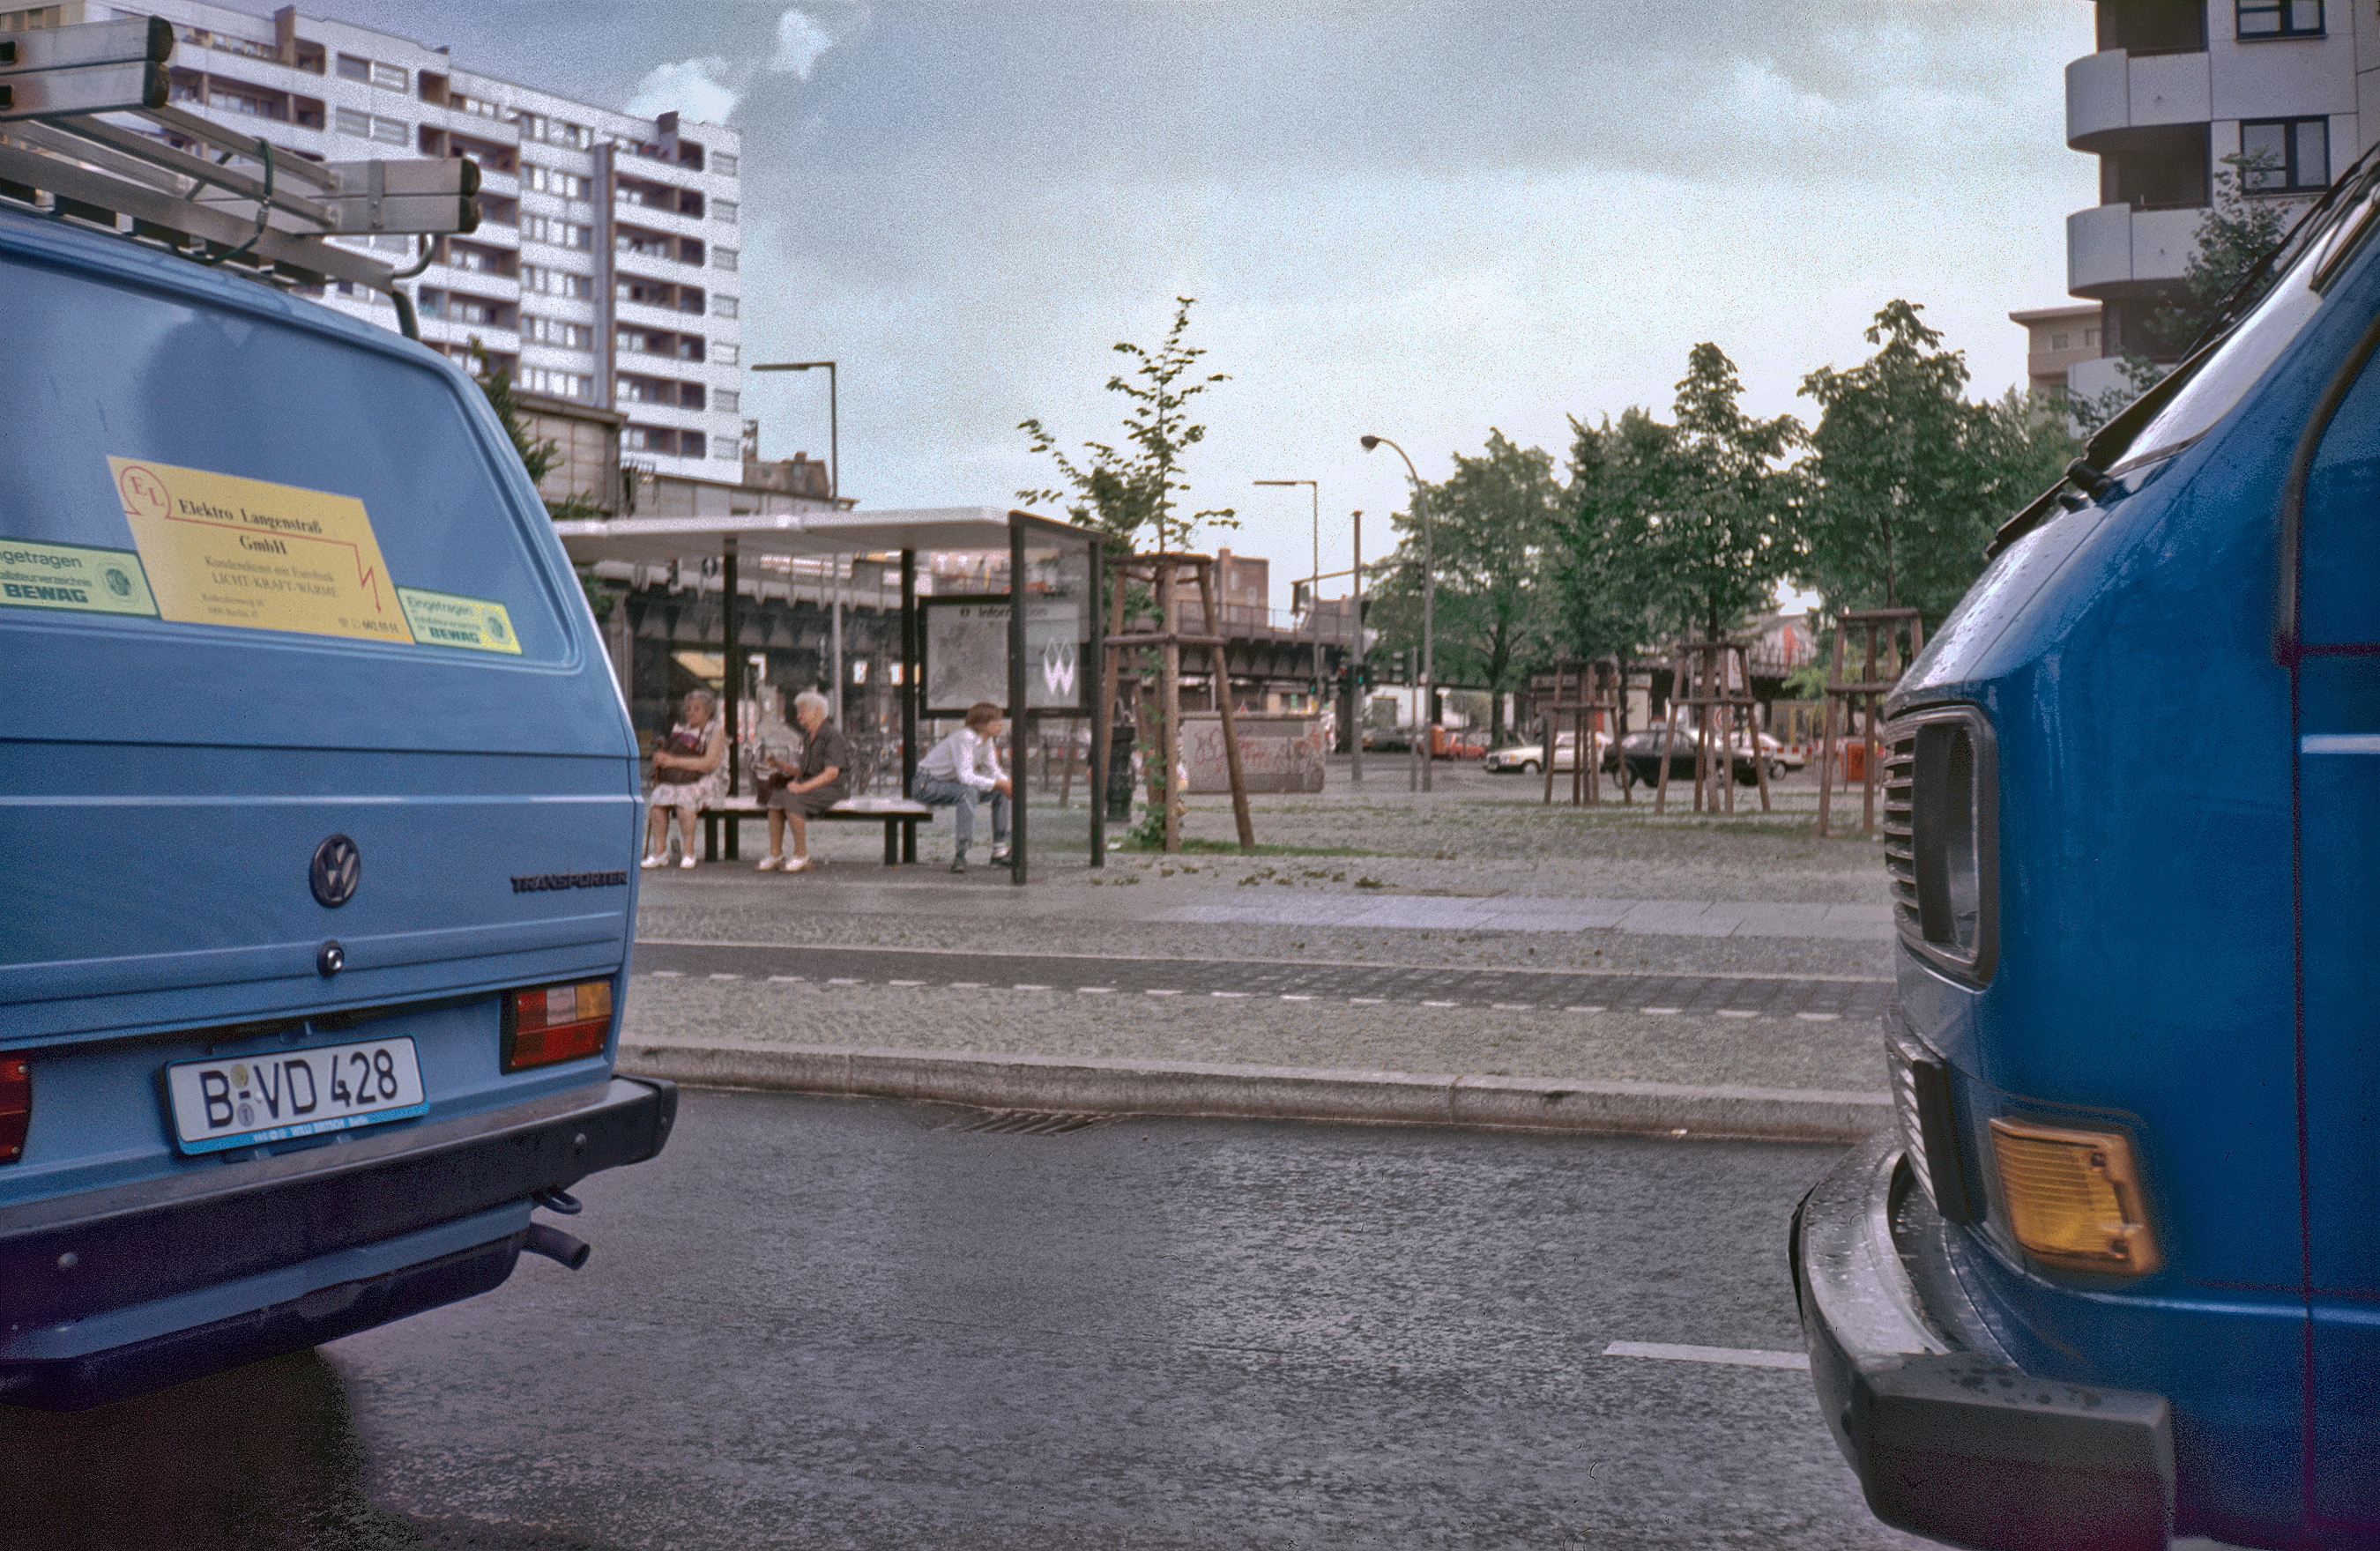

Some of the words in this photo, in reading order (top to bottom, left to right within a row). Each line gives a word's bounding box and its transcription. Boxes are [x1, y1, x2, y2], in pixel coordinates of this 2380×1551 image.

[179, 499, 234, 521] Elektro
[239, 536, 286, 554] GmbH
[0, 550, 82, 569] getragen
[3, 583, 88, 603] BEWAG
[510, 870, 628, 893] TRANSPORTER
[331, 1049, 398, 1108] 428
